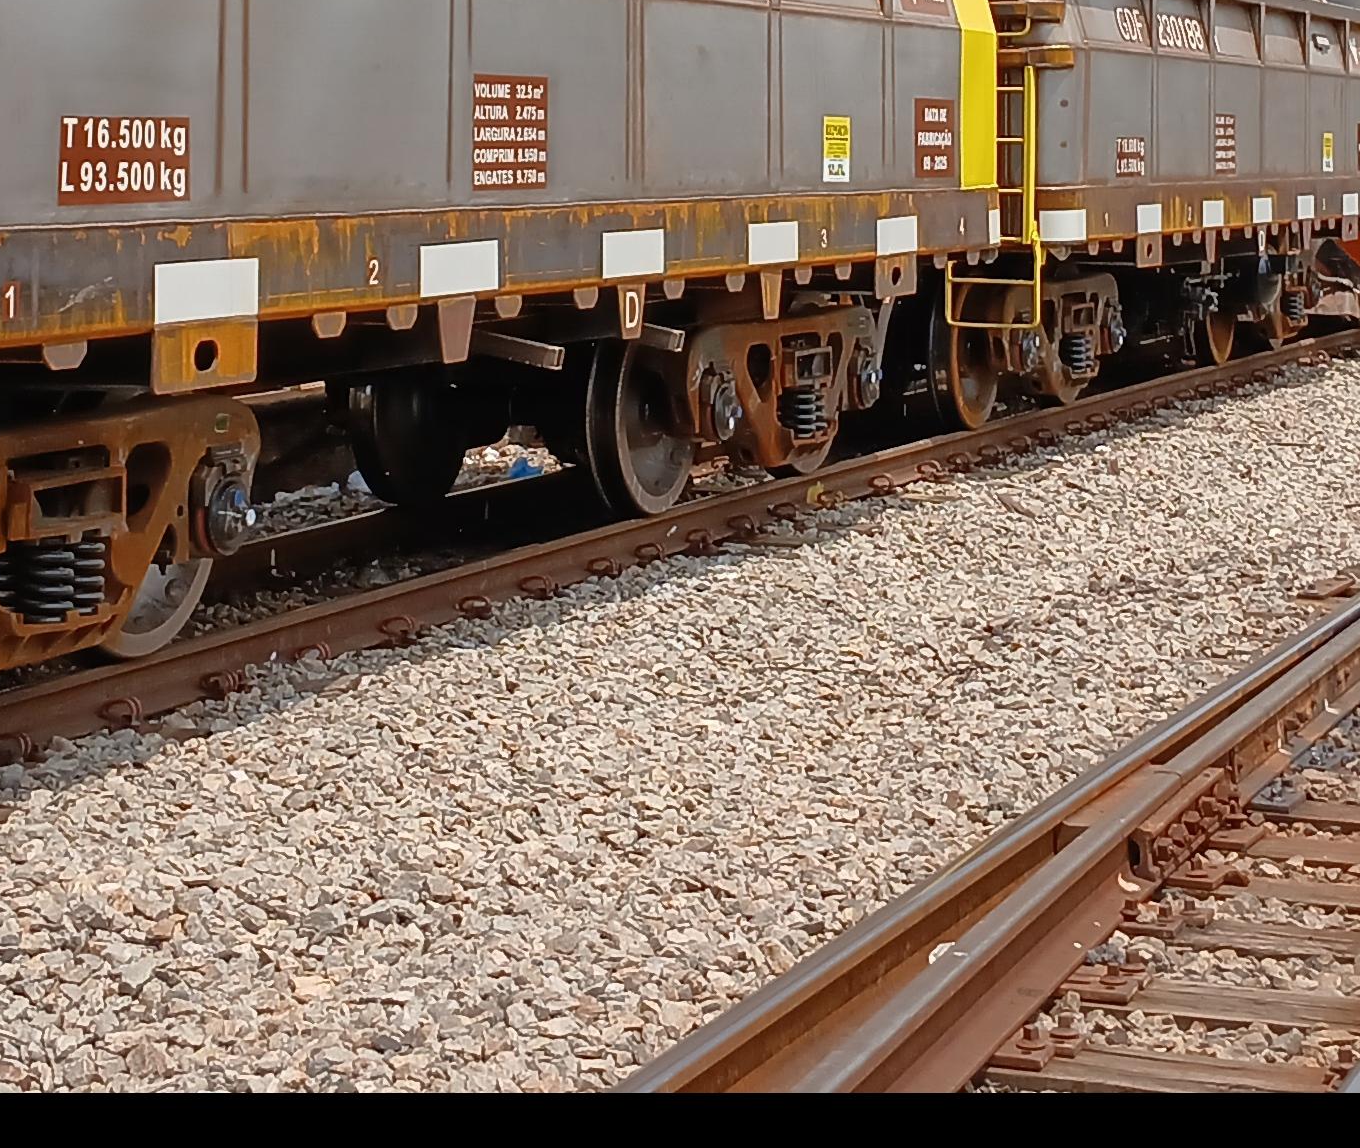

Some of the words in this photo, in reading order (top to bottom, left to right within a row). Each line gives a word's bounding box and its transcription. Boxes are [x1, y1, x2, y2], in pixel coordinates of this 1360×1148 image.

[1116, 7, 1143, 42] GDF
[1156, 14, 1205, 51] 230188
[474, 83, 511, 99] VOLUME
[474, 105, 509, 120] ALTURA
[515, 105, 537, 120] 2.475
[63, 117, 79, 148] T
[83, 117, 156, 149] 16.500
[160, 119, 186, 156] kg
[474, 127, 515, 142] LARGURA
[60, 161, 75, 192] L
[79, 161, 155, 192] 93.500
[160, 161, 186, 197] kg
[474, 170, 514, 185] ENGATES
[821, 228, 828, 248] 3
[369, 259, 379, 285] 2
[4, 285, 15, 319] 1
[625, 291, 639, 329] D
